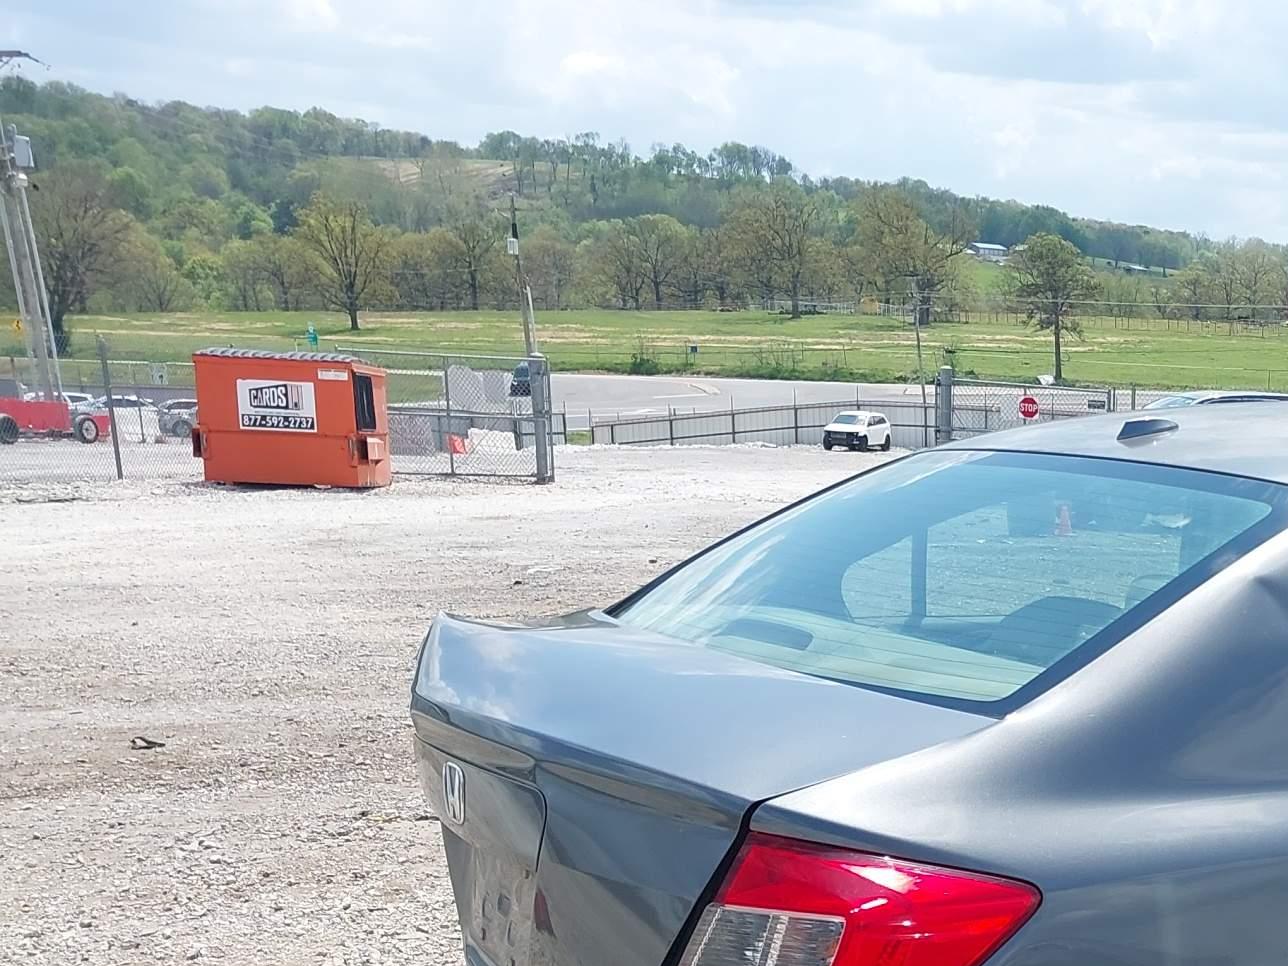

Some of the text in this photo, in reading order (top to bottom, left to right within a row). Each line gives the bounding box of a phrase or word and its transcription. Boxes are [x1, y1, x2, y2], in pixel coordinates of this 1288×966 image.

[250, 386, 287, 407] CARDS
[1019, 403, 1038, 412] STOP
[243, 414, 312, 429] 877-592-2737
